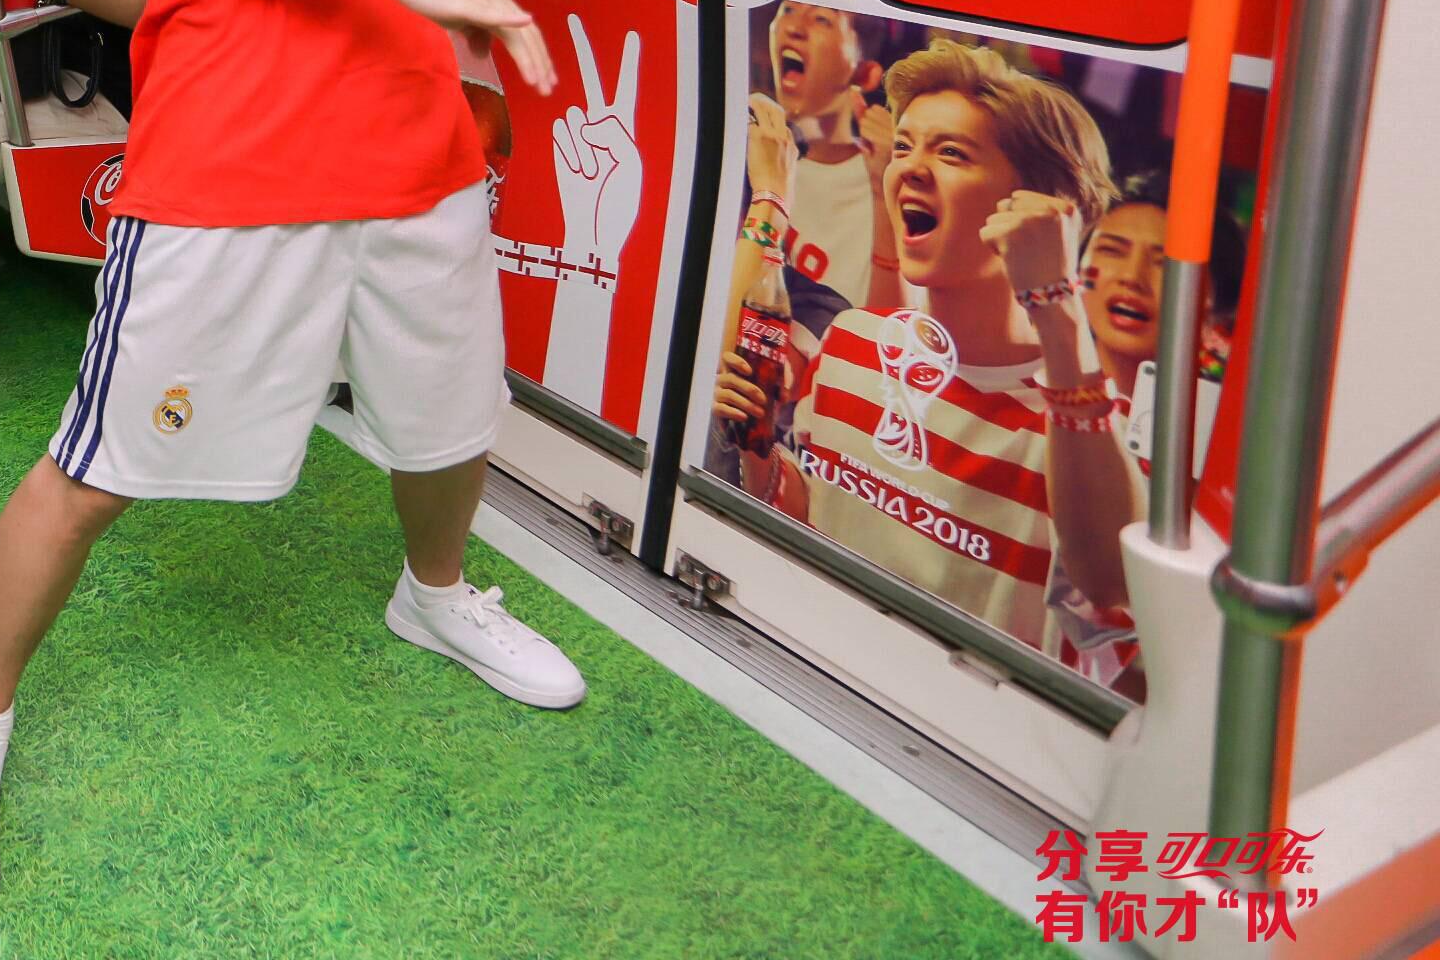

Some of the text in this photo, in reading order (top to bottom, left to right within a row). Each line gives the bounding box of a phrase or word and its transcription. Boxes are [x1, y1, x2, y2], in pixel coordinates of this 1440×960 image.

[799, 449, 991, 562] RUSSIA 2018
[840, 453, 869, 474] FIFA
[870, 466, 907, 492] WORLD
